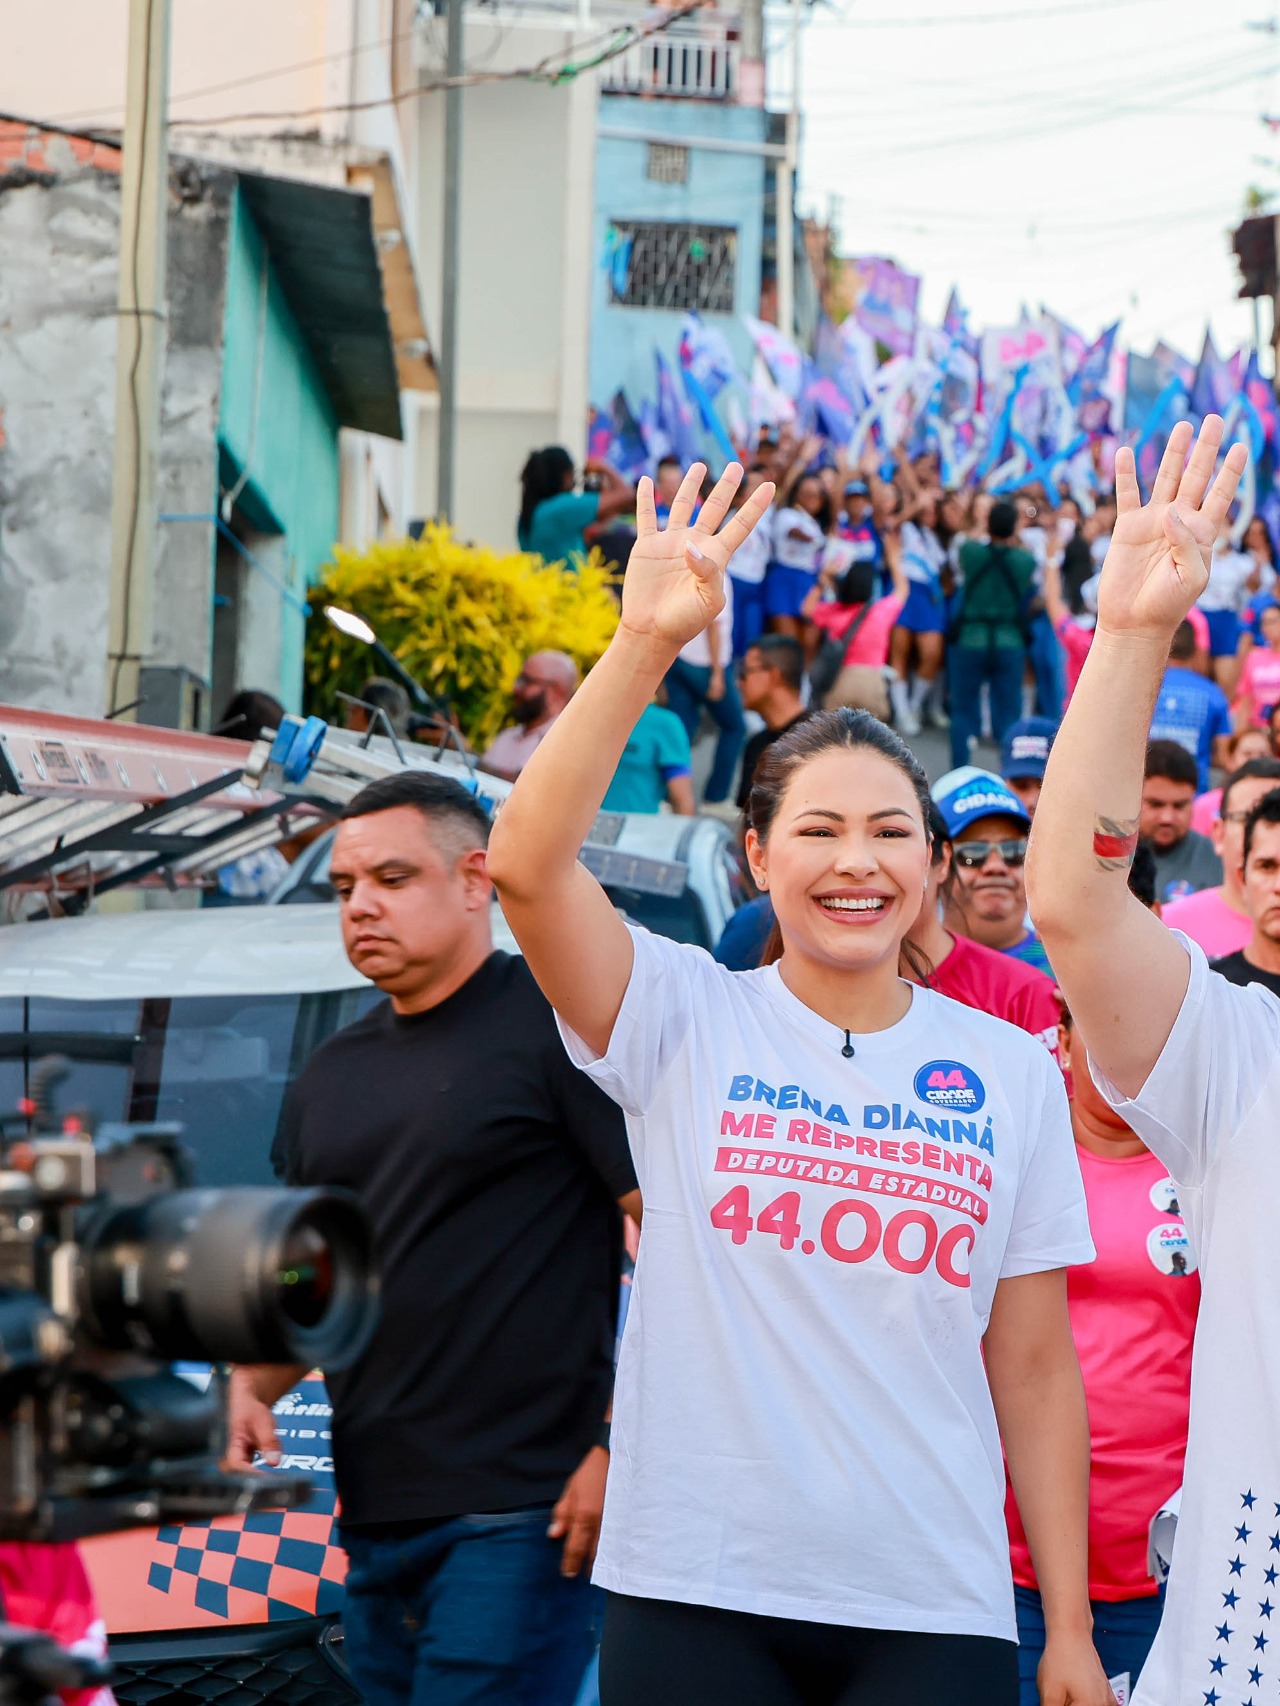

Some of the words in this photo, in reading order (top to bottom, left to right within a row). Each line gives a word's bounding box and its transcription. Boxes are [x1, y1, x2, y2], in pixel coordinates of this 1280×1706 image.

[926, 1089, 976, 1100] CIDADE
[927, 1069, 967, 1089] 44
[728, 1074, 850, 1126] BRENA
[863, 1103, 995, 1157] DIANNÁ
[720, 1110, 777, 1139] ME
[787, 1118, 993, 1193] REPRESENTA
[727, 1152, 860, 1187] DEPUTADA
[868, 1173, 982, 1217] ESTADUAL
[1160, 1227, 1183, 1239] 44
